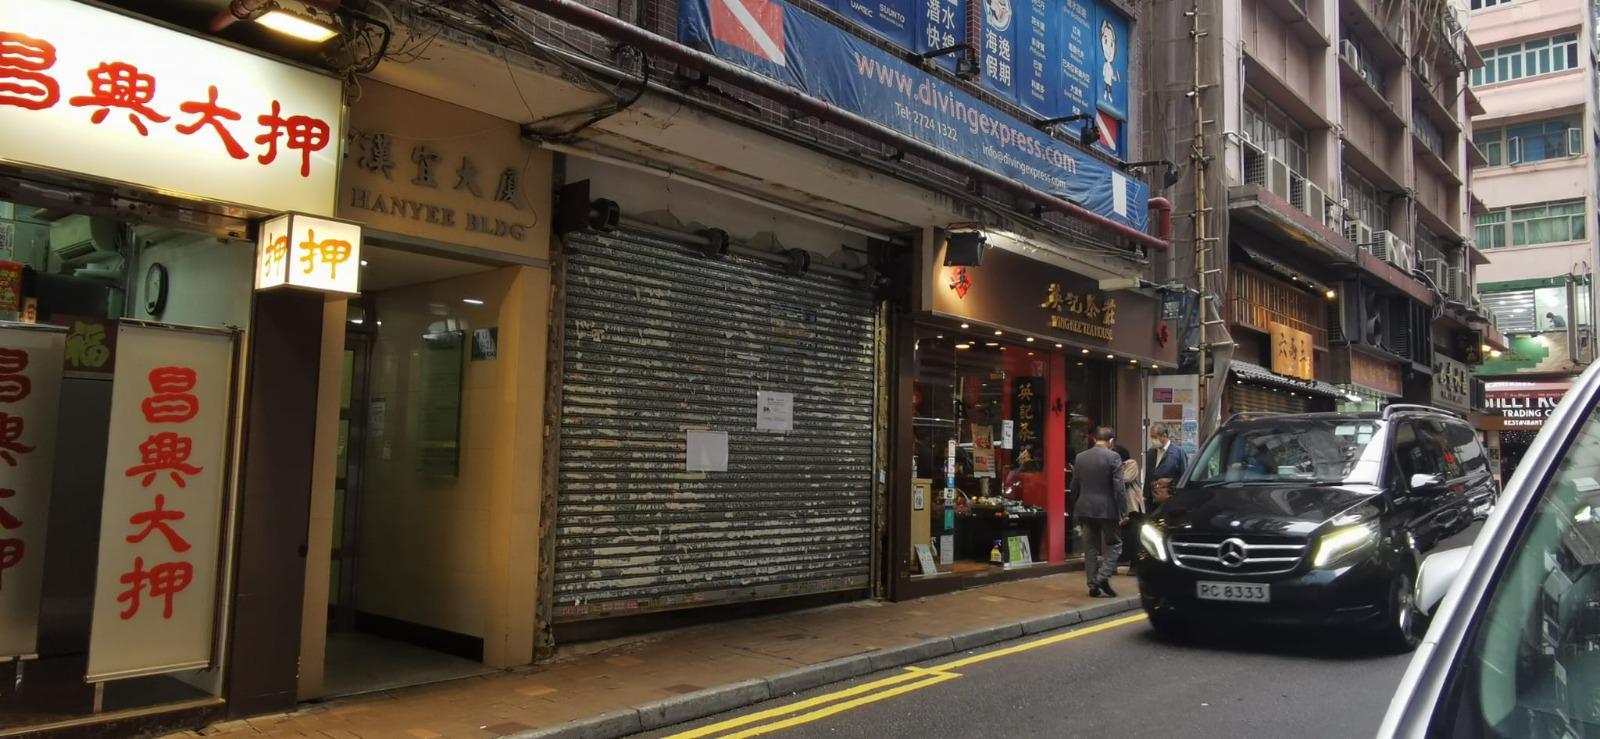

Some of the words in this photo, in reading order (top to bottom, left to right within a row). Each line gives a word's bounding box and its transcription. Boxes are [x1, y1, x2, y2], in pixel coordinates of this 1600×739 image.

[986, 29, 1011, 61] 海逸
[986, 54, 1011, 87] 假期
[854, 51, 1077, 175] www.divingexpress.com
[895, 101, 911, 120] Tel:
[913, 110, 935, 131] 2724
[937, 121, 958, 142] 1322
[357, 133, 524, 210] 漢宜大廈
[351, 187, 455, 227] HANYEE
[465, 212, 526, 242] BLDG
[265, 232, 288, 277] 押
[299, 228, 352, 280] 押
[64, 320, 109, 369] 福
[1502, 409, 1541, 417] TRADING
[117, 366, 204, 620] 昌興大押
[1200, 584, 1219, 597] RC
[1224, 585, 1264, 599] 8333
